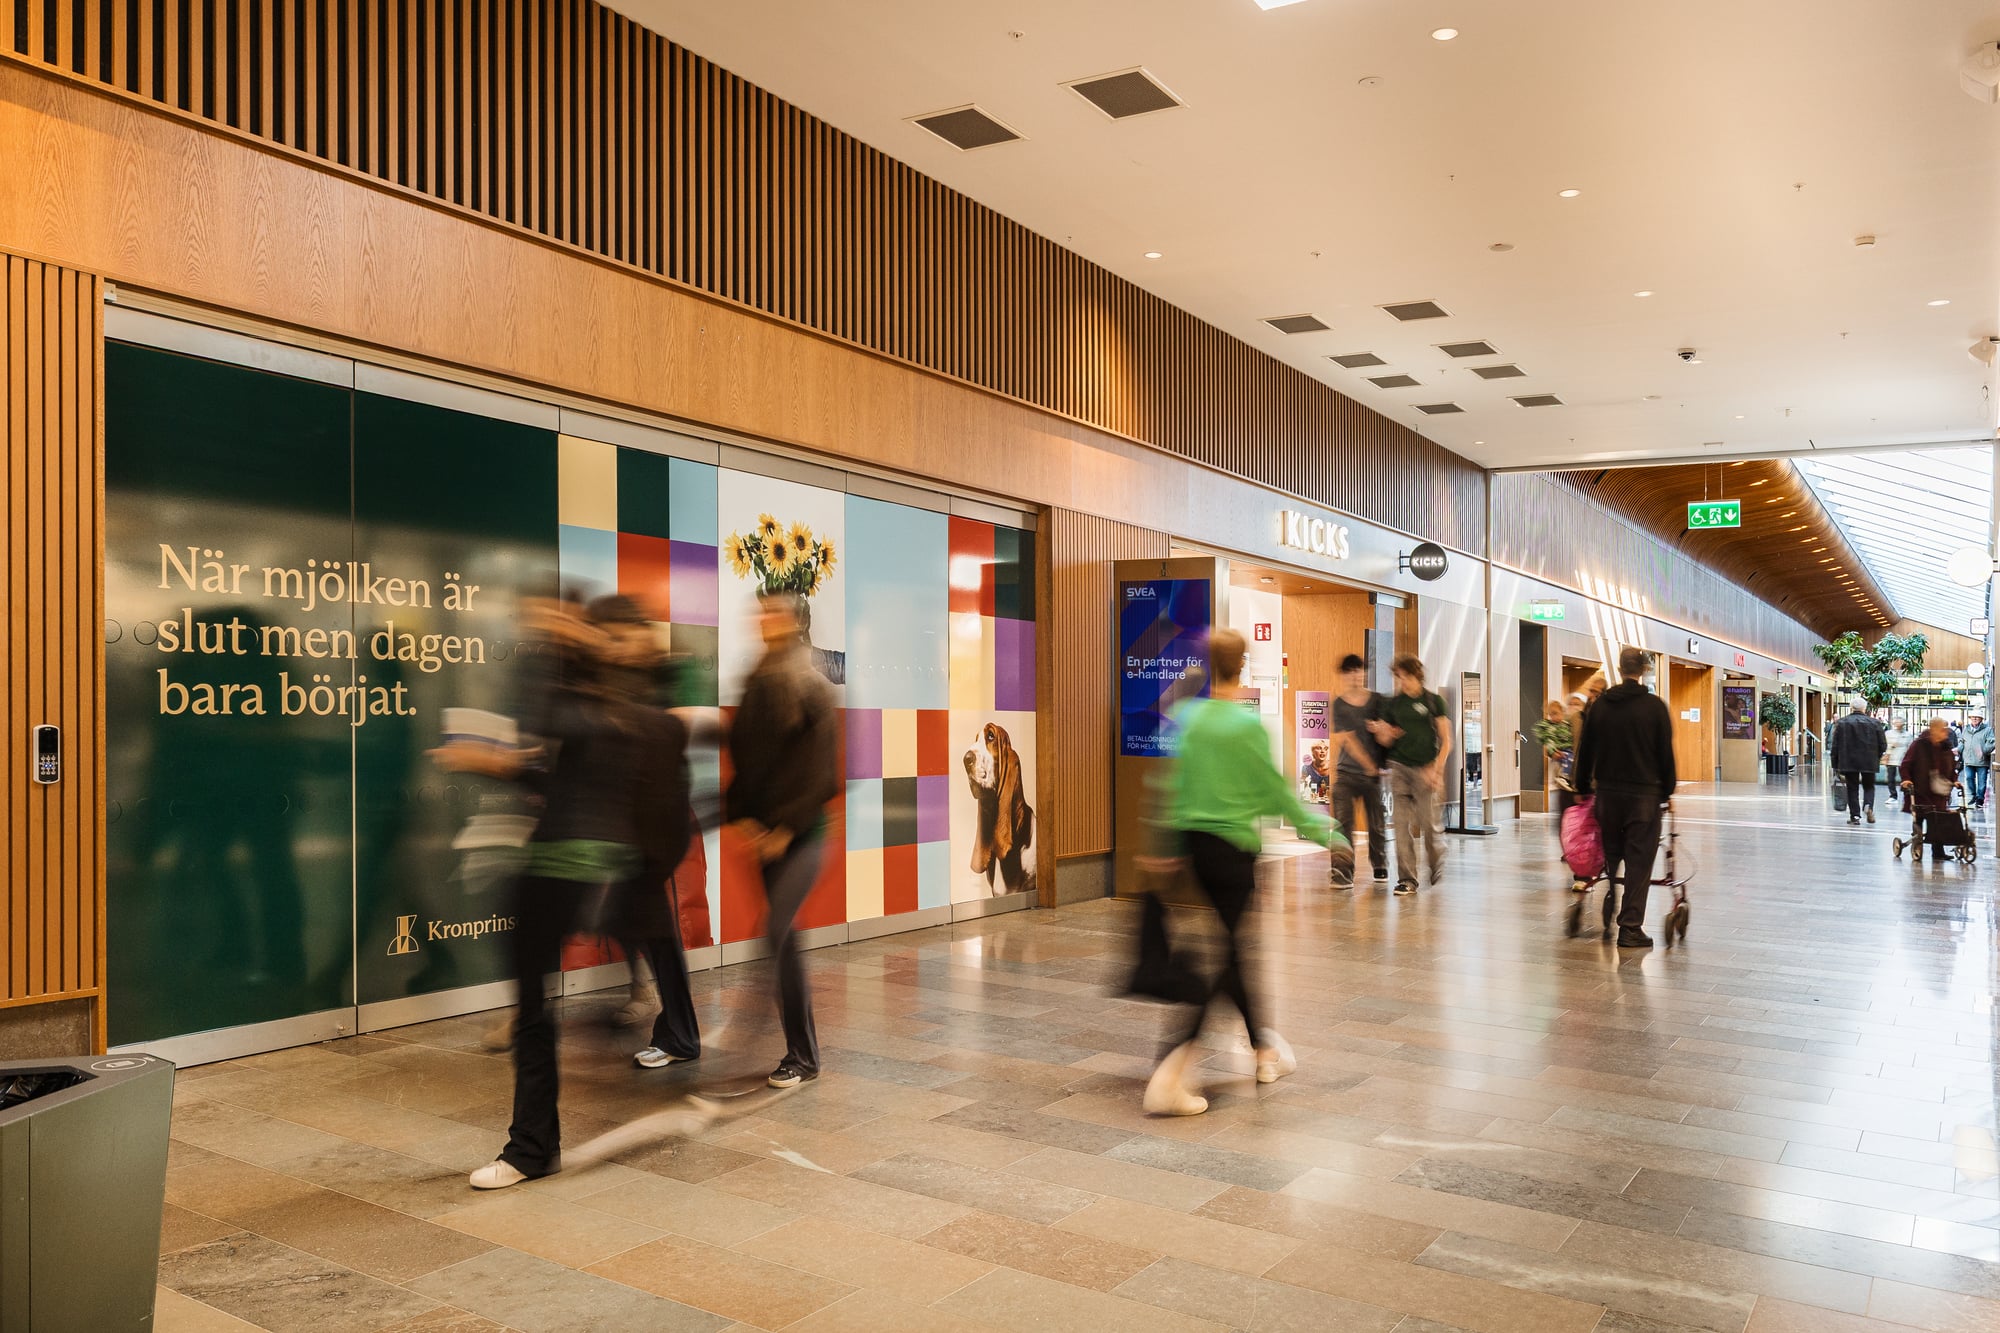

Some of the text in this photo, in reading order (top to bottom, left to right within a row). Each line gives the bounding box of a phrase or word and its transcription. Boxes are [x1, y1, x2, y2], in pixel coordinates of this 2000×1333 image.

[1282, 510, 1350, 560] KICKS
[1411, 557, 1444, 567] KICKS
[157, 543, 481, 612] När mjölken är
[1126, 587, 1156, 597] SVEA
[157, 607, 487, 674] slut men dagen
[1126, 655, 1203, 669] En partner för
[1126, 668, 1186, 680] e-handlare
[157, 668, 417, 727] bara börjat.
[1301, 718, 1328, 730] 30%
[1126, 742, 1140, 750] FÖR
